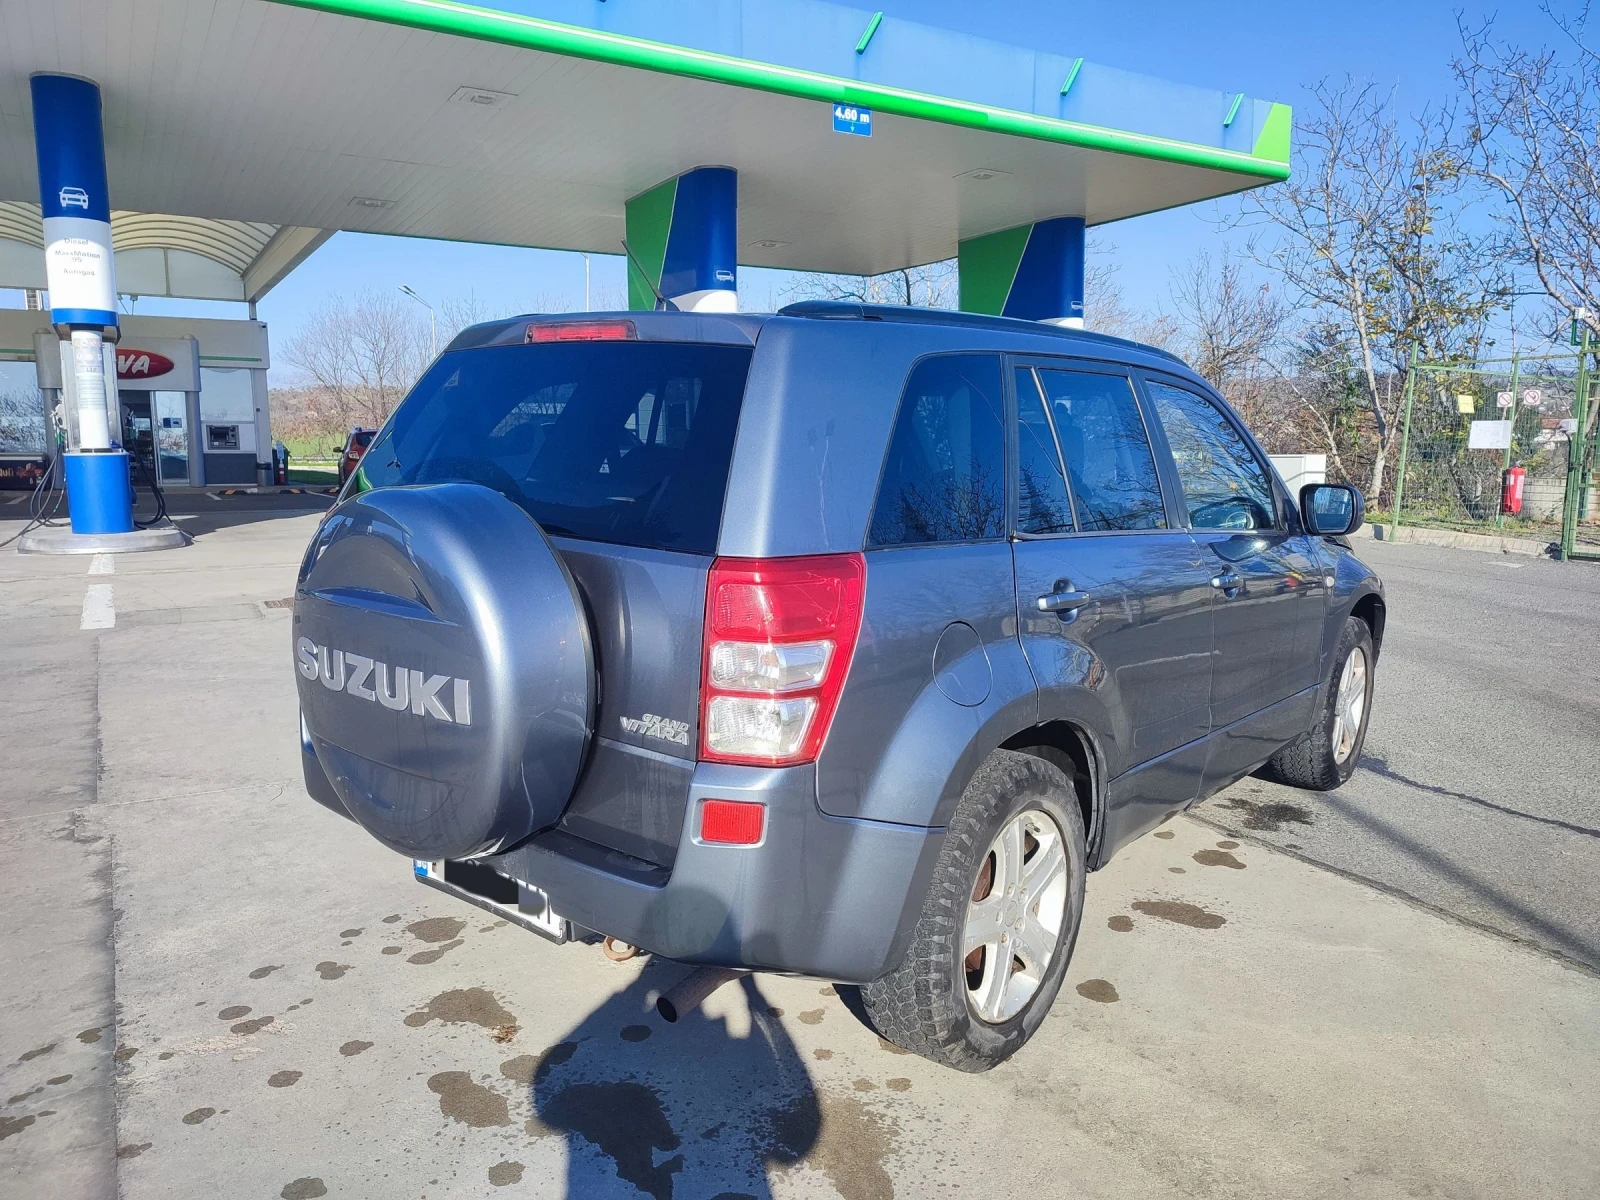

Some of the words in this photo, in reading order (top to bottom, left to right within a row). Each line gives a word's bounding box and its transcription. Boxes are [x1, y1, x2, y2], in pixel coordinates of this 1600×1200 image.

[835, 107, 857, 121] 4.60
[860, 113, 870, 123] m
[63, 237, 89, 245] Diesel
[54, 250, 101, 259] MaxxMotion
[63, 268, 96, 276] Autogas
[296, 636, 472, 726] SUZUKI
[641, 713, 689, 732] GRAND
[619, 716, 690, 746] VITARA
